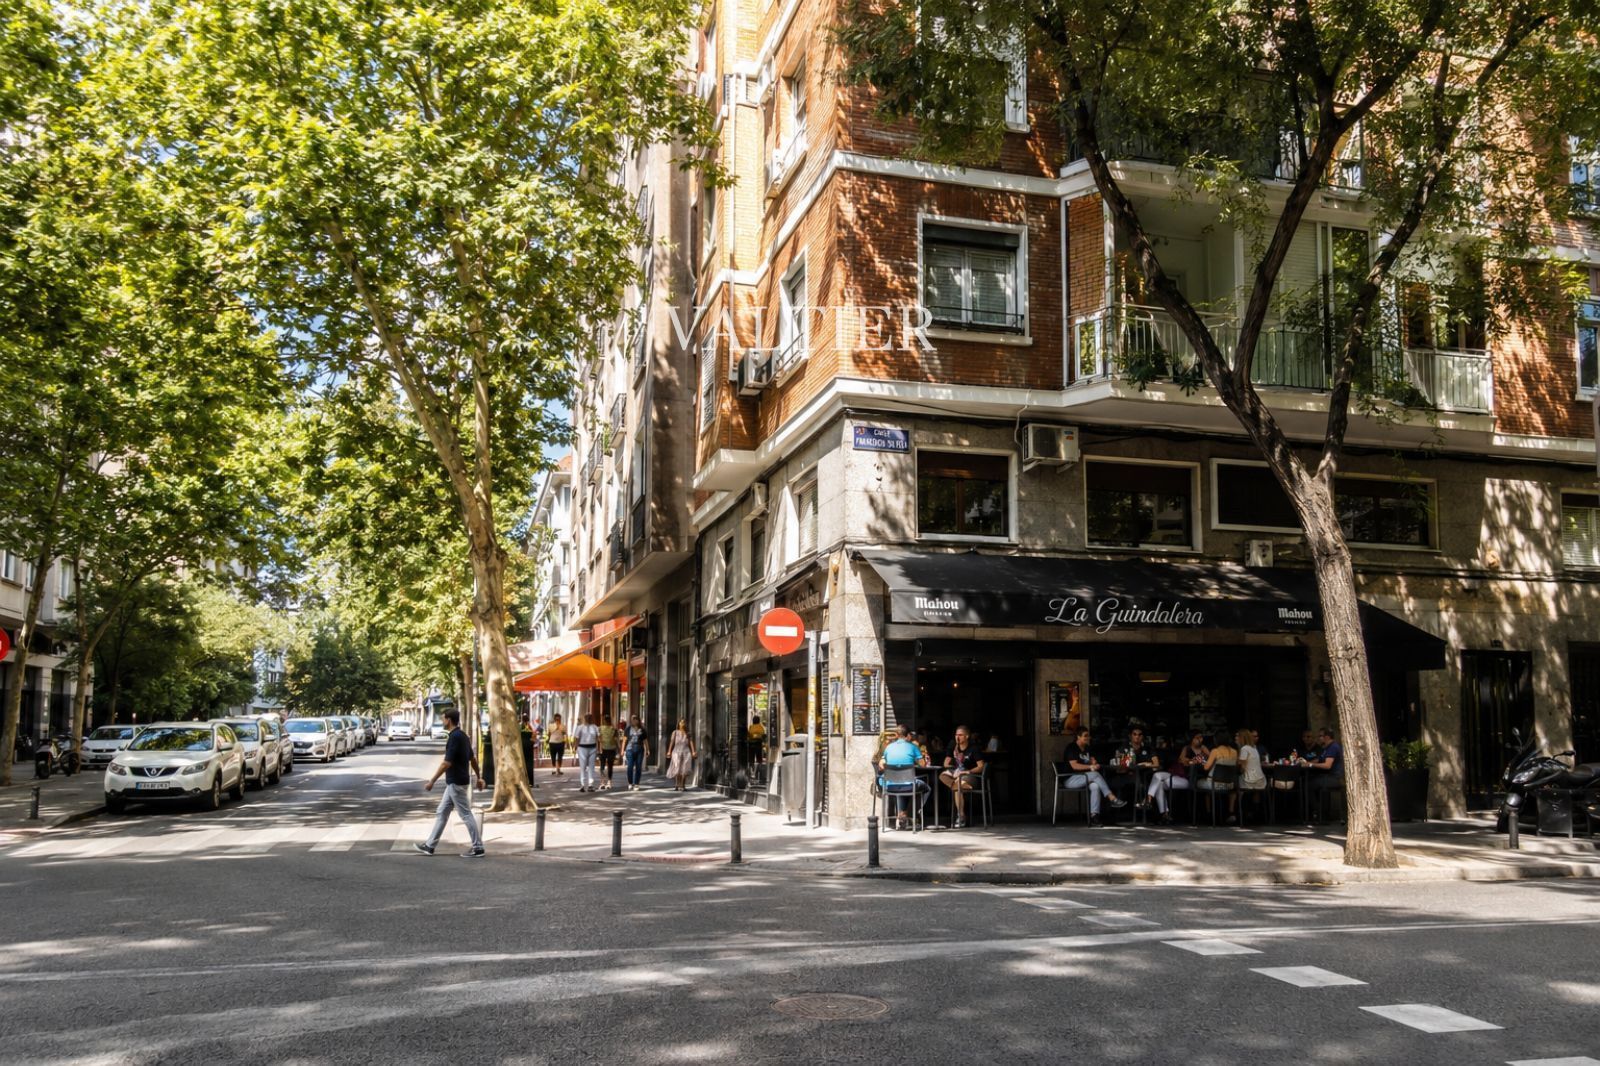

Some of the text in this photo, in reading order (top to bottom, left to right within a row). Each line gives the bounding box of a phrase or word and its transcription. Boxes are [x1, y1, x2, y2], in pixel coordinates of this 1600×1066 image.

[914, 596, 960, 610] Mahou
[1044, 597, 1204, 634] La Guindalera
[1277, 607, 1313, 619] Mahou
